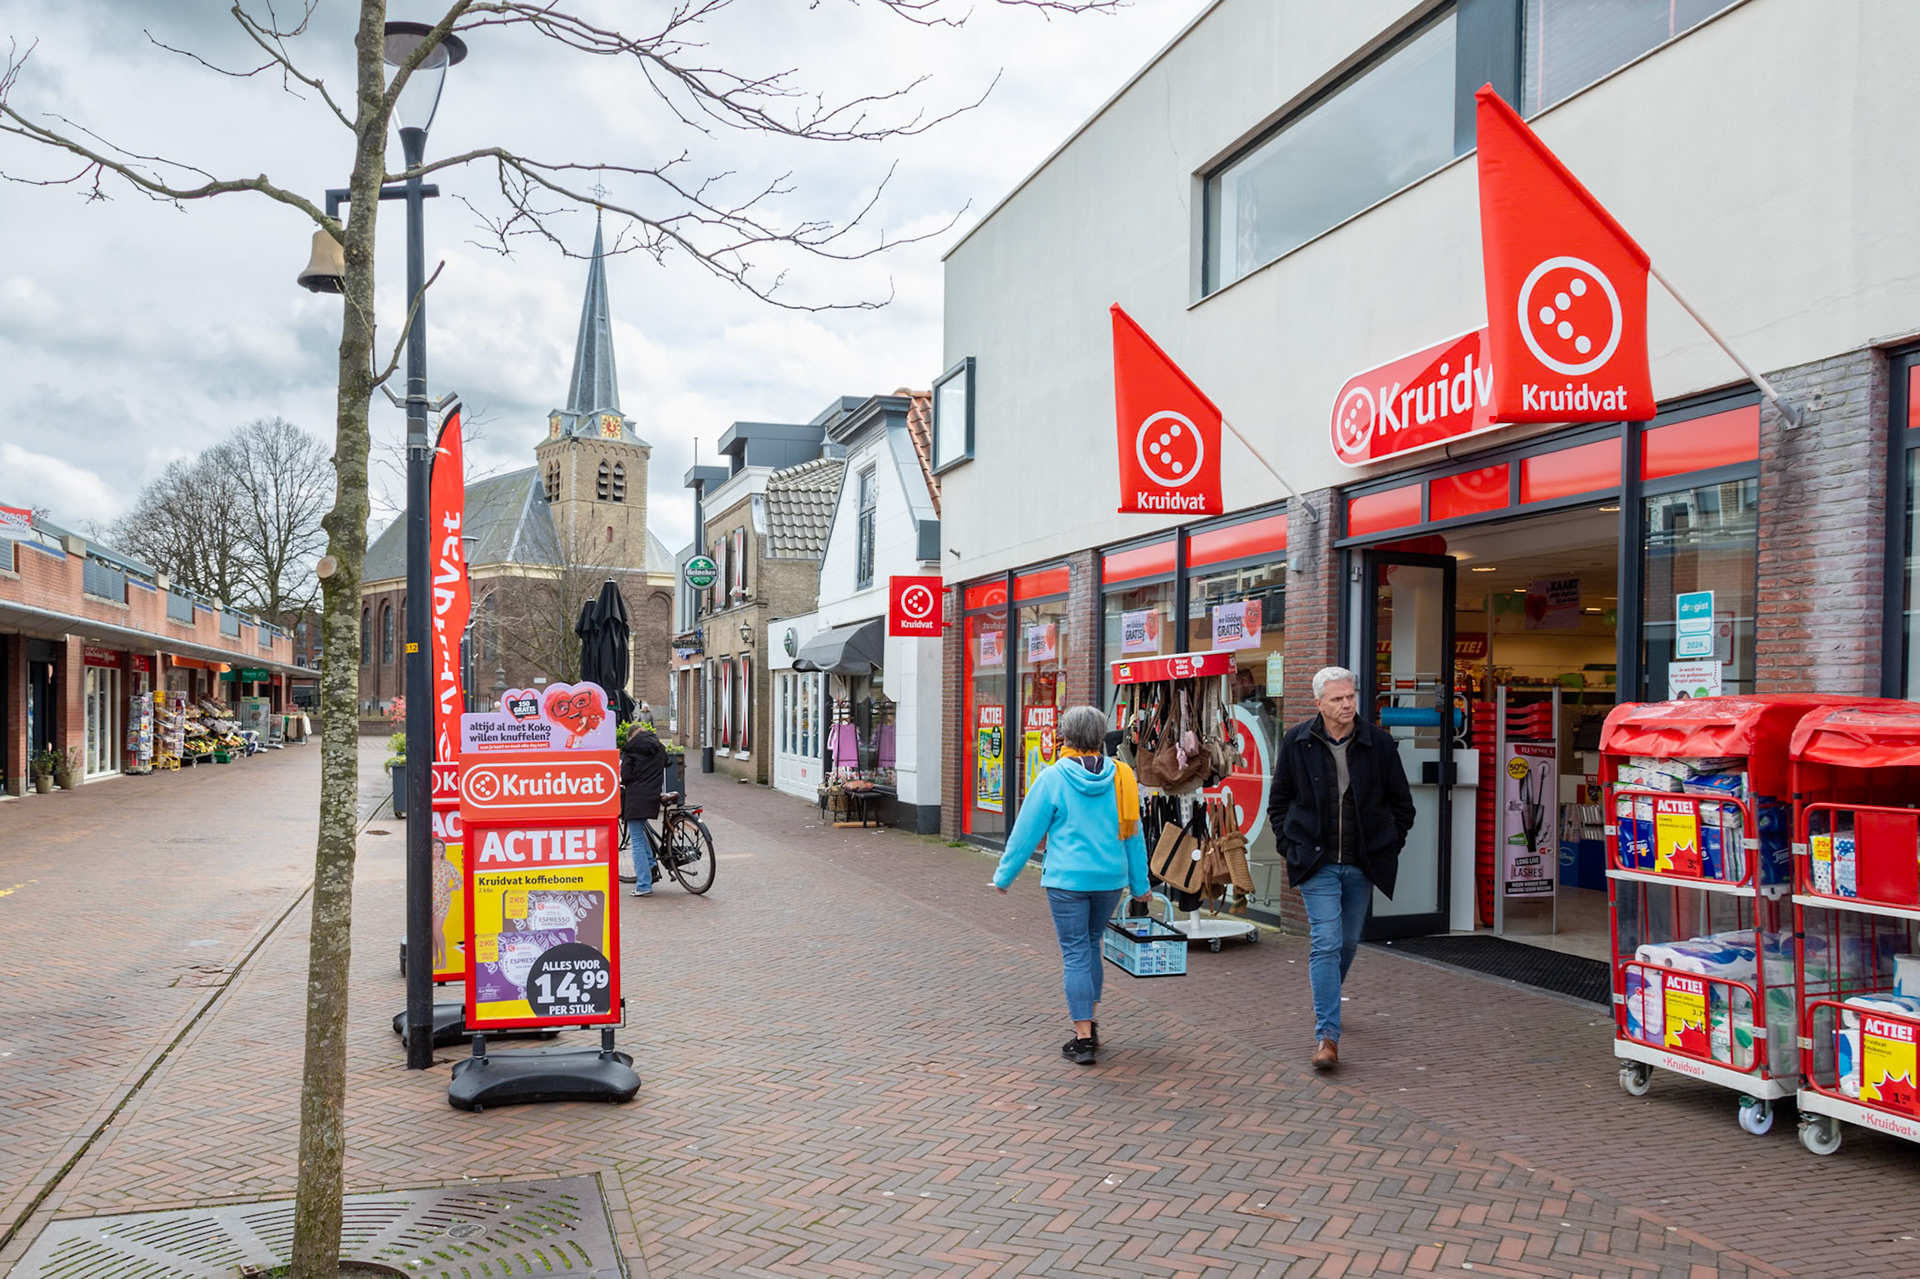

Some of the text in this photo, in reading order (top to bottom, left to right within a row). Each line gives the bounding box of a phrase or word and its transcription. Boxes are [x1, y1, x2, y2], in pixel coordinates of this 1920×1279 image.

[1378, 353, 1493, 436] Kruidv
[1522, 383, 1628, 412] Kruidvat
[1136, 491, 1206, 510] Kruidvat
[1681, 601, 1709, 612] drogist
[901, 619, 934, 629] Kruidvat
[1217, 622, 1243, 638] GRATIS!
[1125, 627, 1145, 641] GRATIS!
[1686, 641, 1703, 649] 2024
[514, 705, 536, 713] GRATIS
[980, 707, 1002, 724] ACTIE!
[1028, 707, 1054, 726] ACTIE!
[469, 723, 552, 733] altijd al met Koko
[469, 732, 551, 742] willen knuffelen?
[1521, 746, 1554, 756] RIMMEL
[1509, 763, 1528, 771] 50%
[503, 771, 605, 797] Kruidvat
[1657, 799, 1694, 814] ACTIE!
[479, 828, 597, 863] ACTIE!
[1513, 867, 1543, 878] LASHES
[478, 875, 584, 886] Kruidvat koffiebonen
[510, 956, 537, 964] ESPRESS
[542, 960, 601, 971] ALLES VOOR
[534, 970, 609, 1003] 14.99
[1666, 975, 1704, 994] ACTIE!
[549, 1004, 595, 1015] PER STUK
[1864, 1018, 1913, 1041] ACTIE!
[1710, 1034, 1734, 1047] eco
[1667, 1056, 1702, 1075] Kruidvat
[1866, 1112, 1912, 1136] Kruidvat
